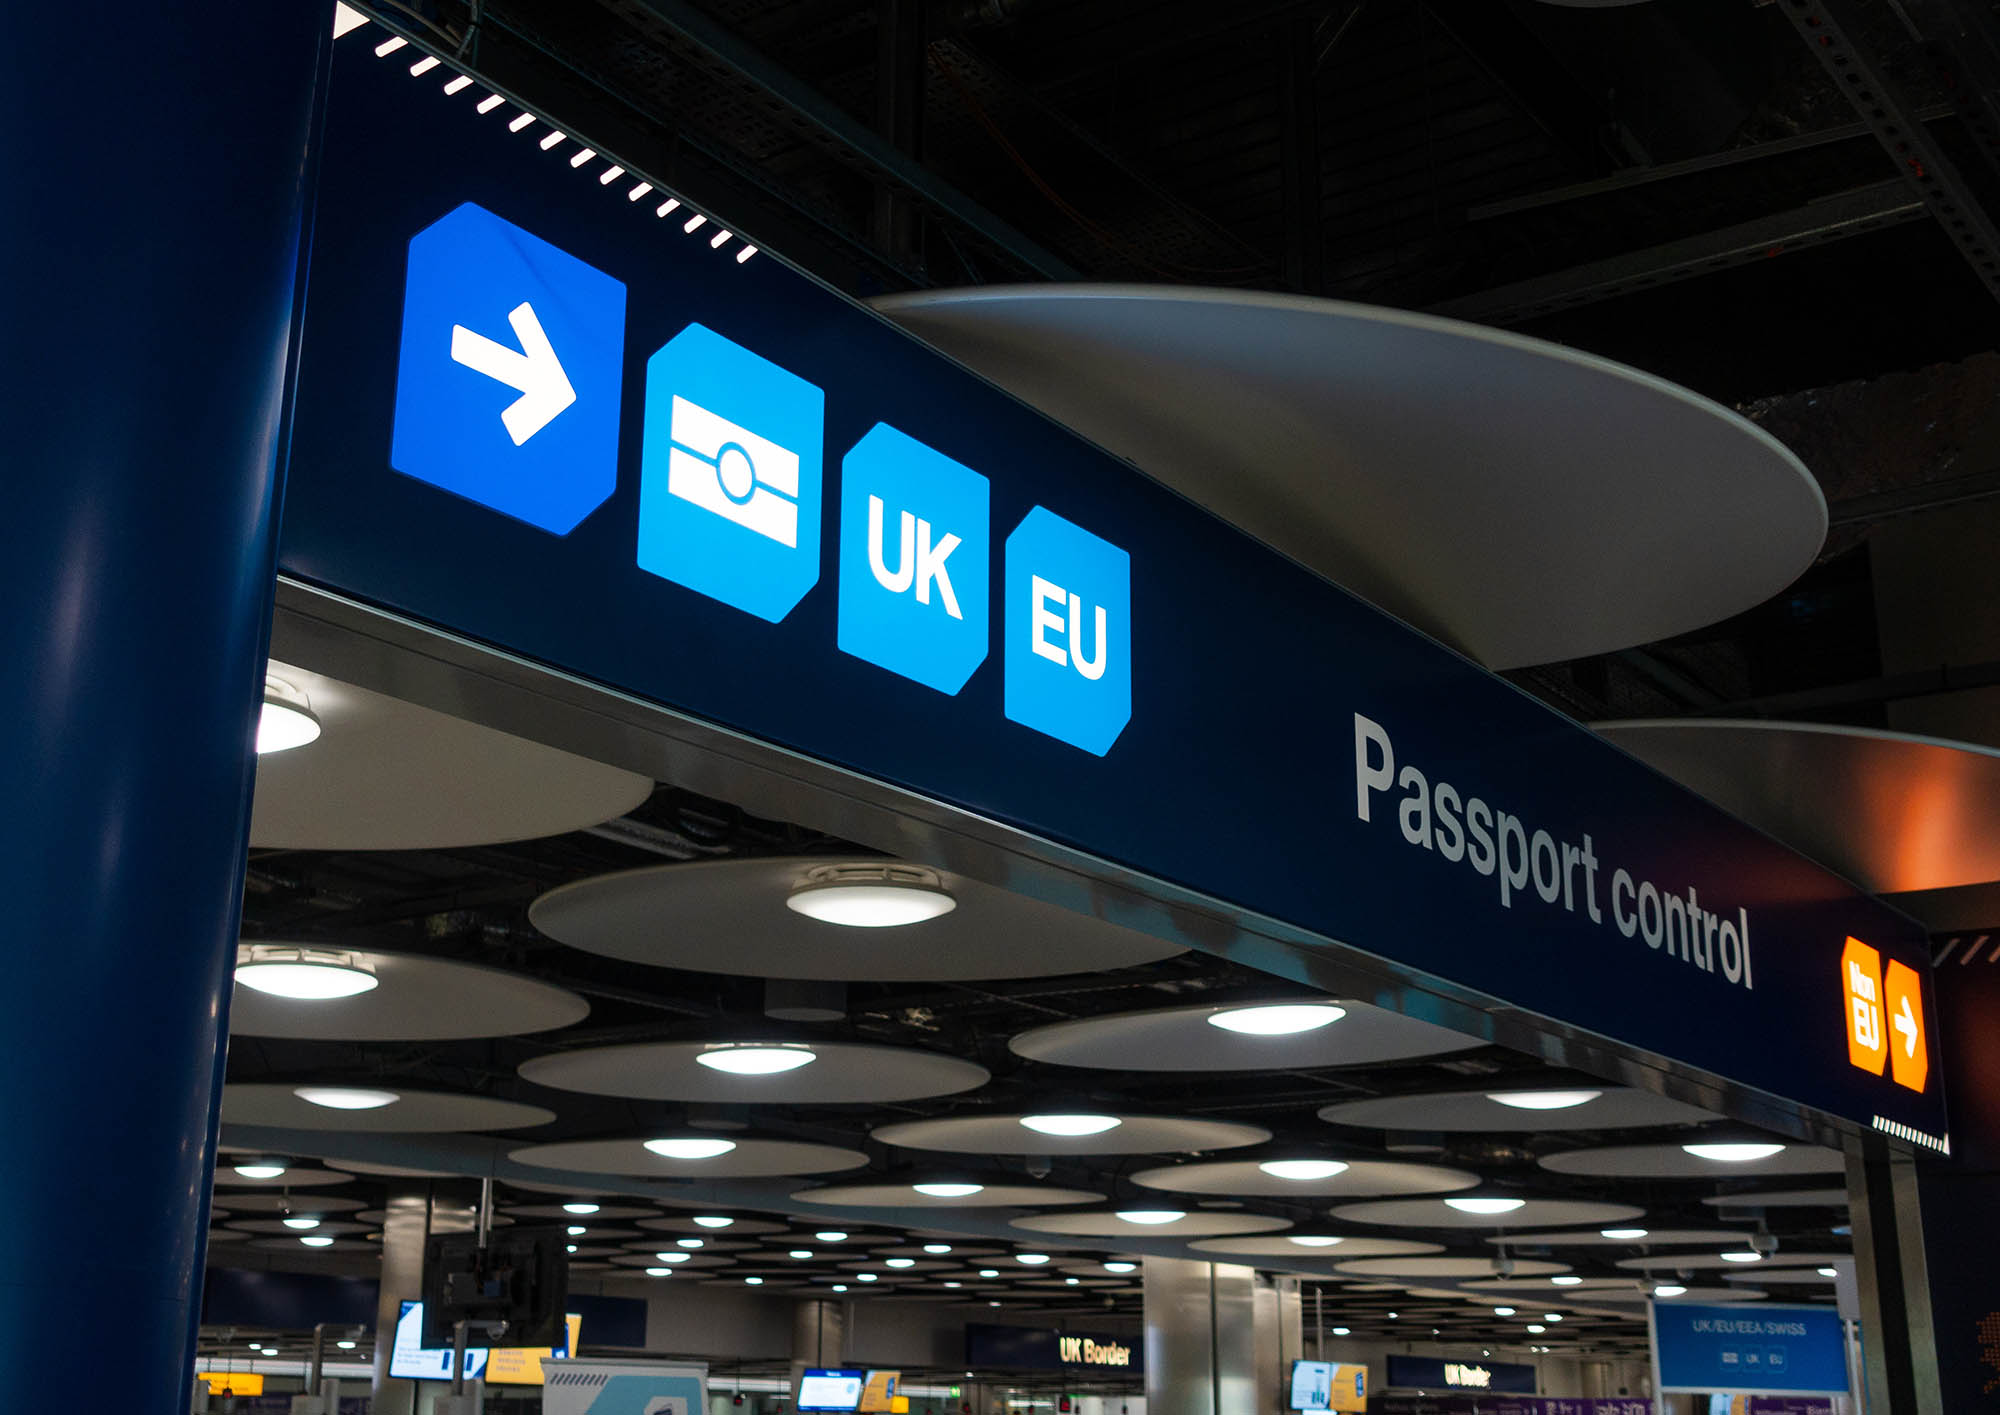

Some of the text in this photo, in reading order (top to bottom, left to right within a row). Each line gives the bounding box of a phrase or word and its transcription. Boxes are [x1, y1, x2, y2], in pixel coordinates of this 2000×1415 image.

[868, 494, 963, 620] UK
[1032, 574, 1106, 680] EU
[1354, 712, 1753, 989] Passport control
[1852, 996, 1880, 1051] EU
[1059, 1336, 1131, 1366] UK Border
